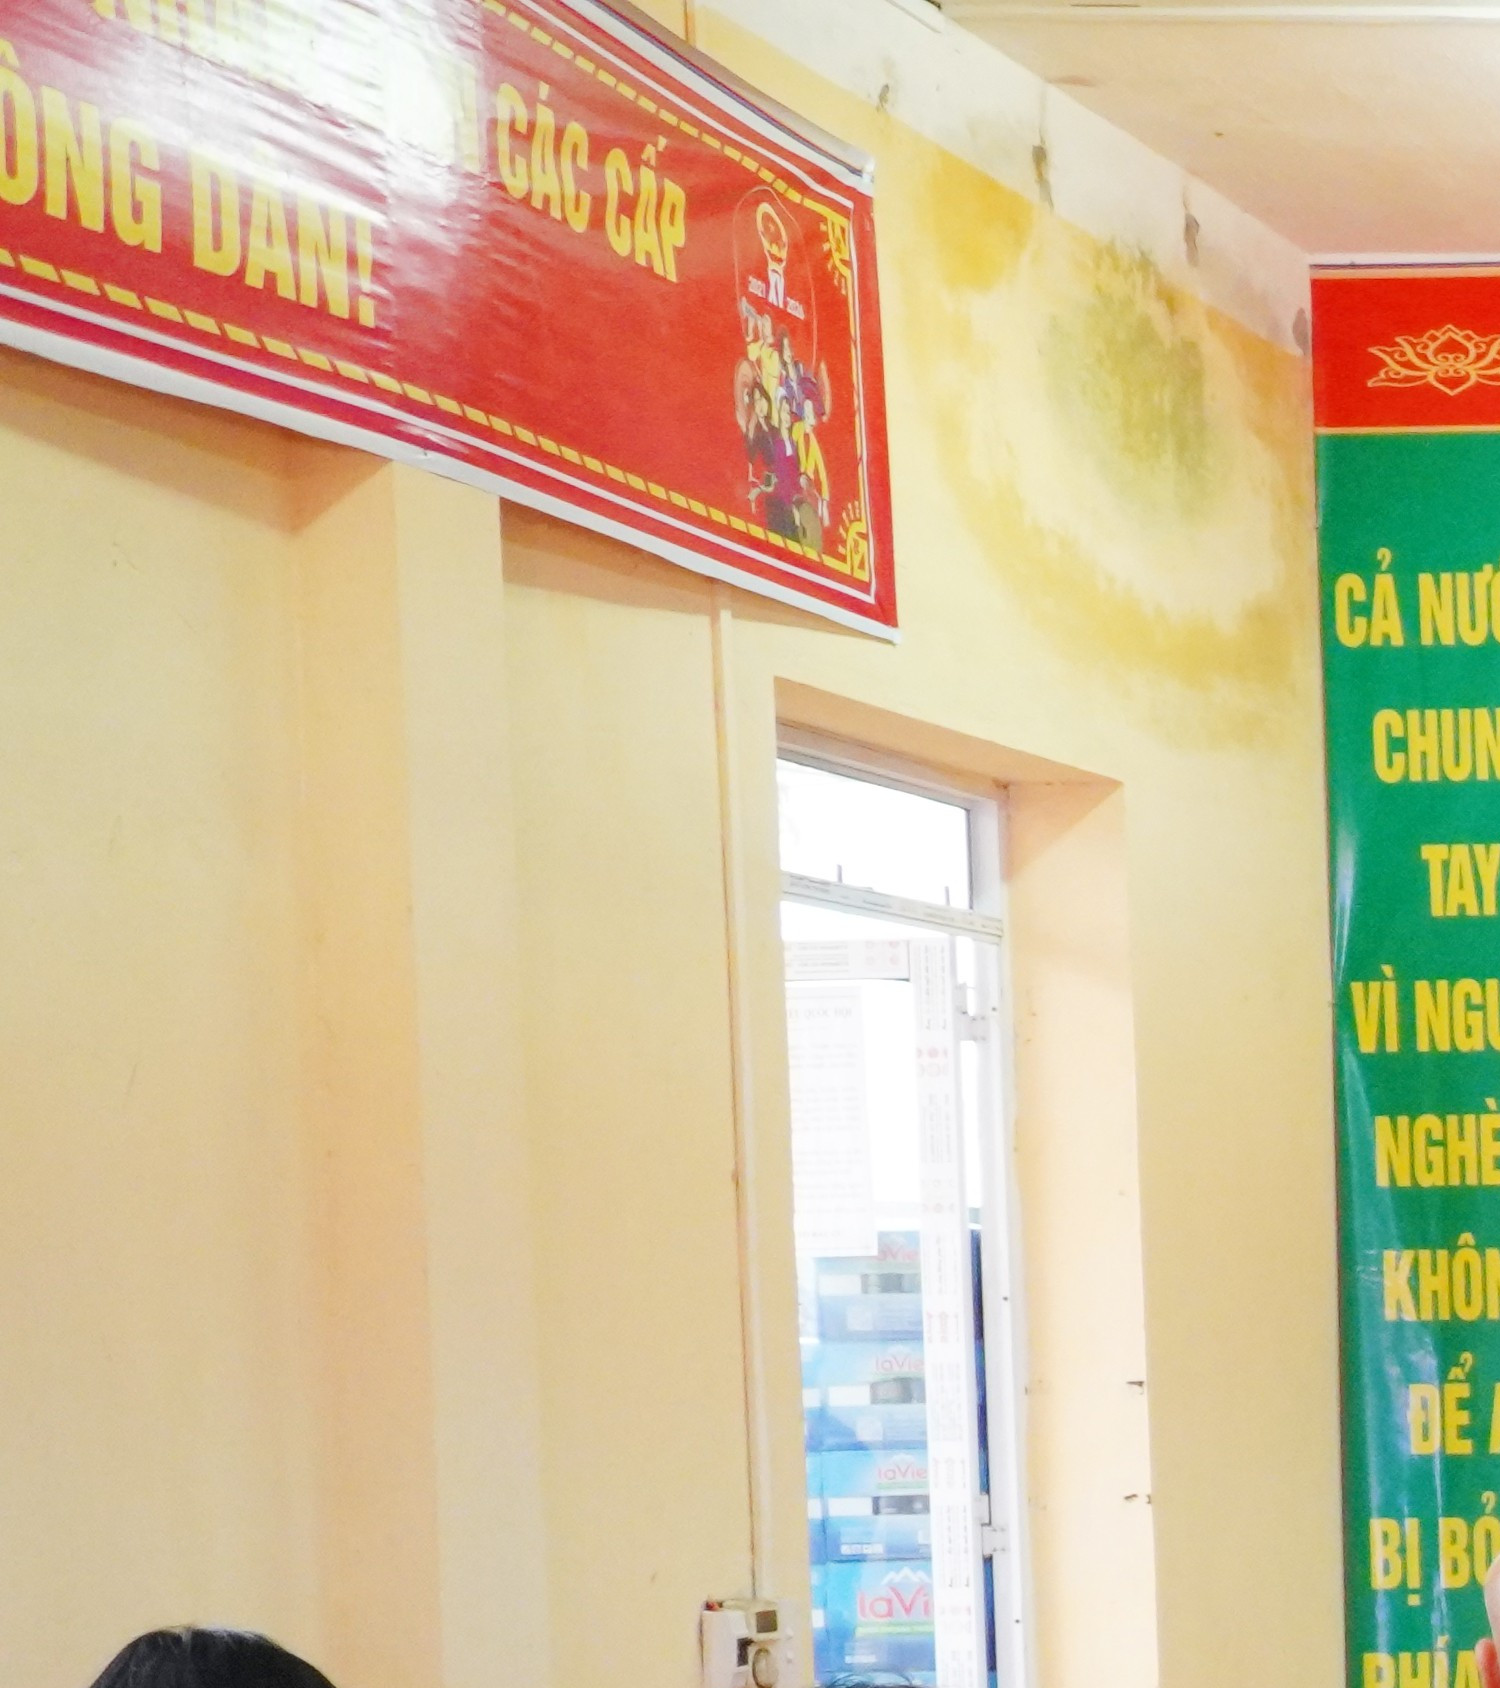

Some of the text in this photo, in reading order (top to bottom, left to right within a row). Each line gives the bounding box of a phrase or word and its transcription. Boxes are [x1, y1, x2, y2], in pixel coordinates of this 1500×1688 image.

[496, 81, 592, 233] CÁC
[605, 135, 686, 283] CẤP
[190, 142, 376, 328] DÂN!
[1335, 547, 1404, 649] CẢ
[1350, 964, 1400, 1054] VÌ
[1407, 1351, 1473, 1456] ĐỂ
[857, 1584, 932, 1620] laVi
[1369, 1517, 1422, 1606] BỊ
